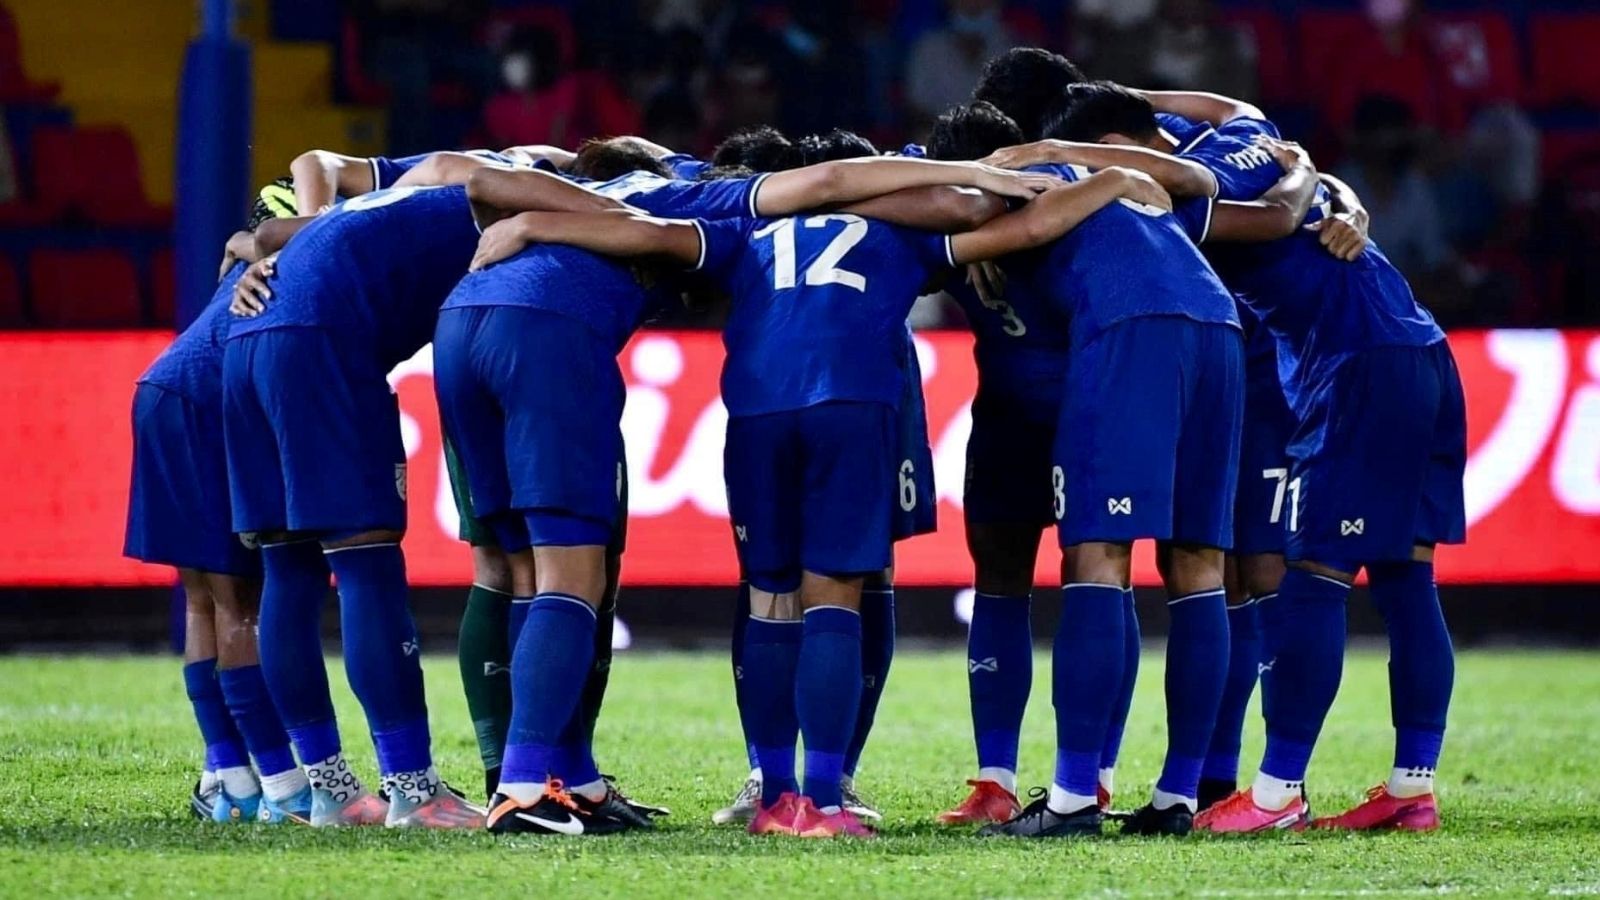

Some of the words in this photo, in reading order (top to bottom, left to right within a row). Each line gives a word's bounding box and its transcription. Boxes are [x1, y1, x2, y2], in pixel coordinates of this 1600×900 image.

[753, 213, 868, 292] 12
[899, 459, 917, 512] 6
[1052, 465, 1066, 520] 8
[1262, 467, 1288, 523] 7
[1287, 476, 1301, 532] 1
